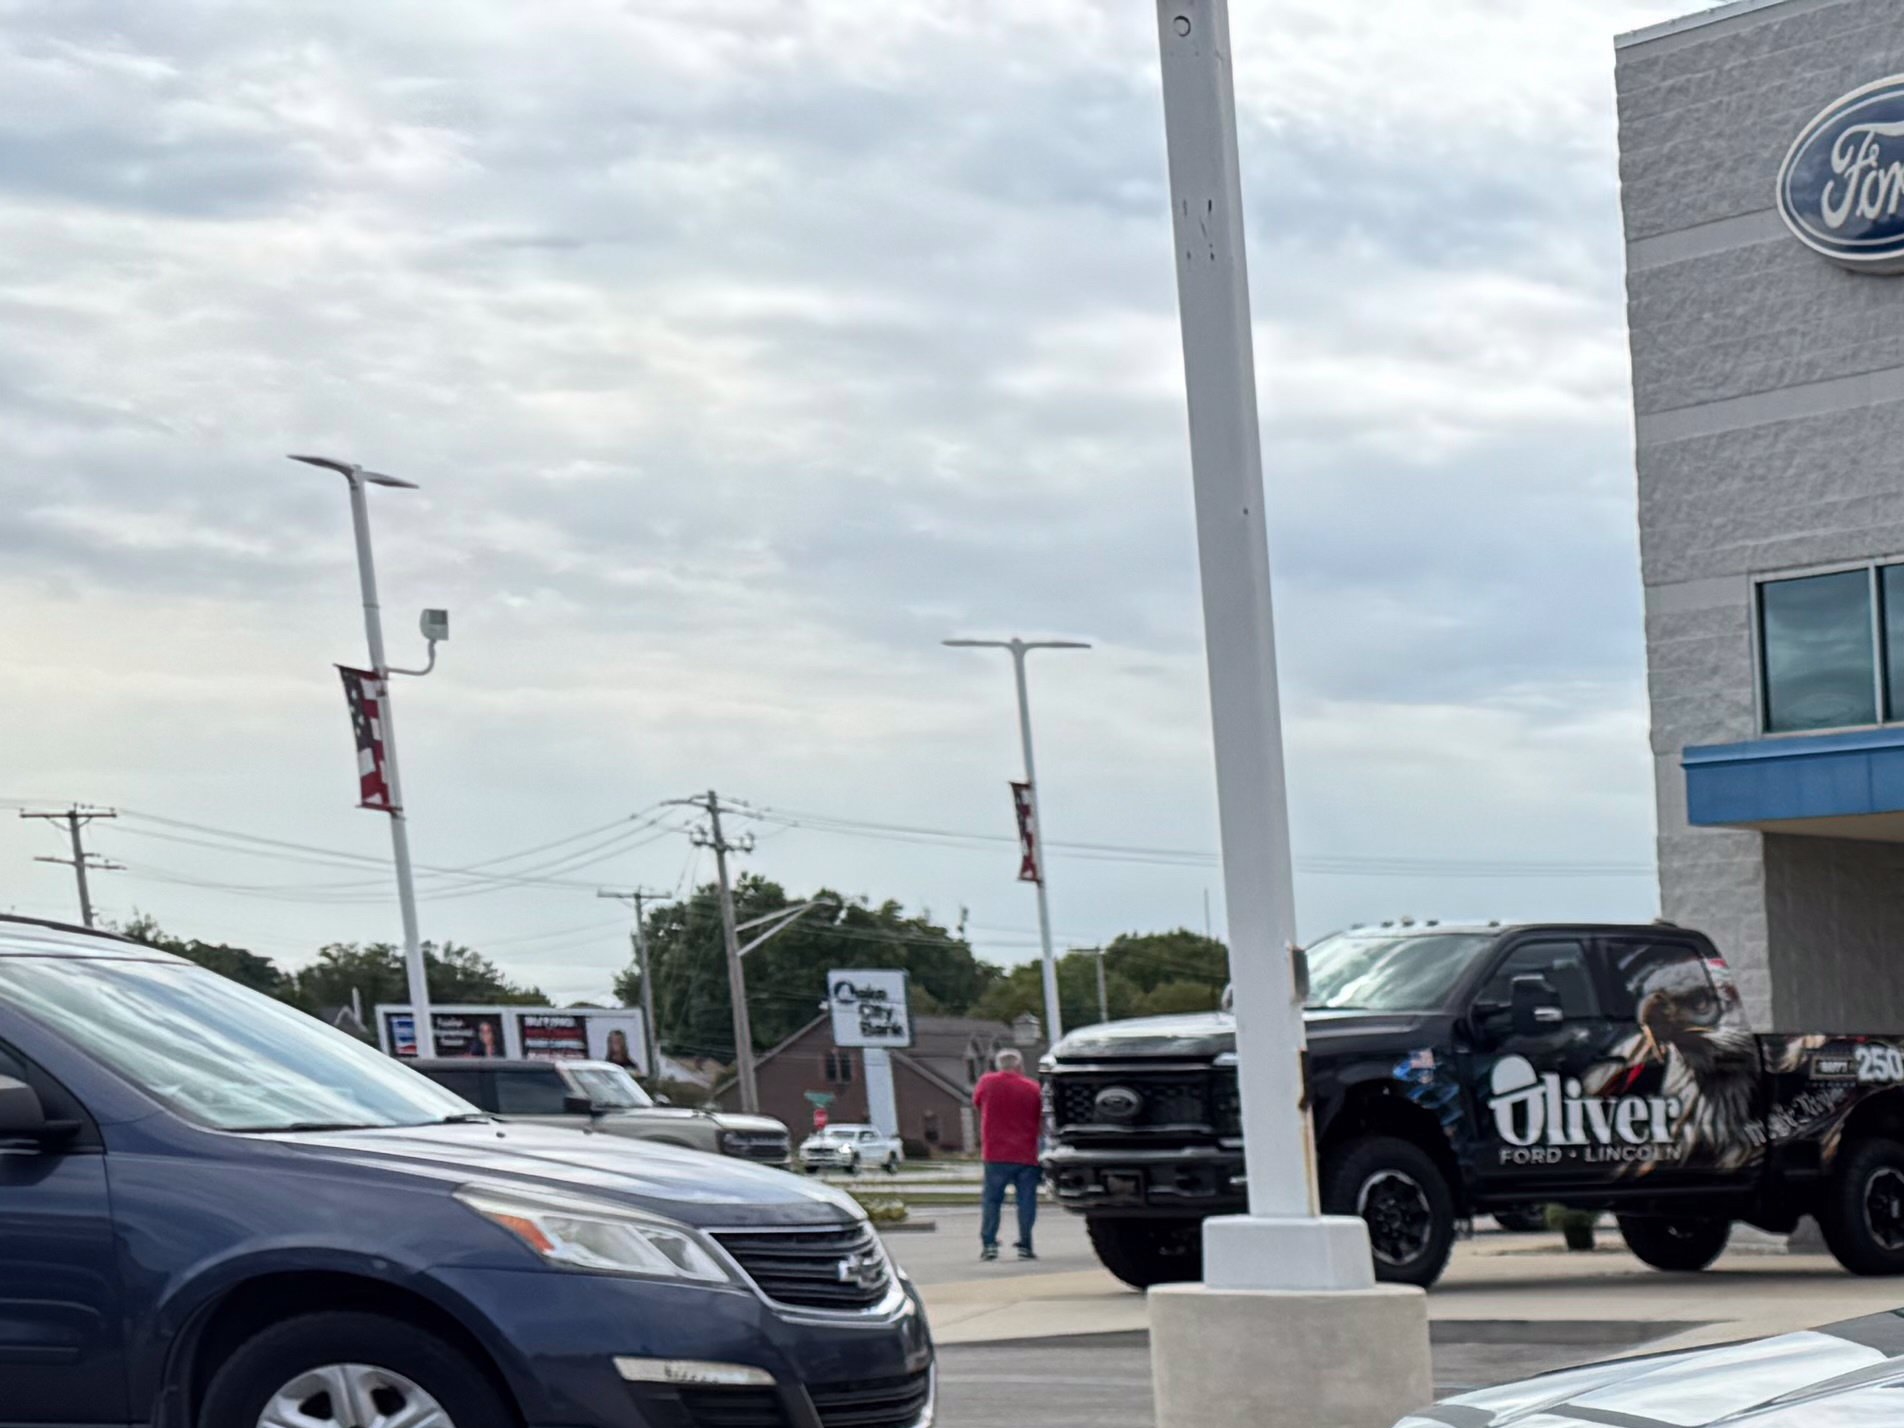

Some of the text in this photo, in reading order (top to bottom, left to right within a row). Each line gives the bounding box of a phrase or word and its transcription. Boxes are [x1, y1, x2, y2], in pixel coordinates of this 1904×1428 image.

[1488, 1054, 1686, 1146] Oliver
[1500, 1146, 1683, 1165] FORD LINCOLN
